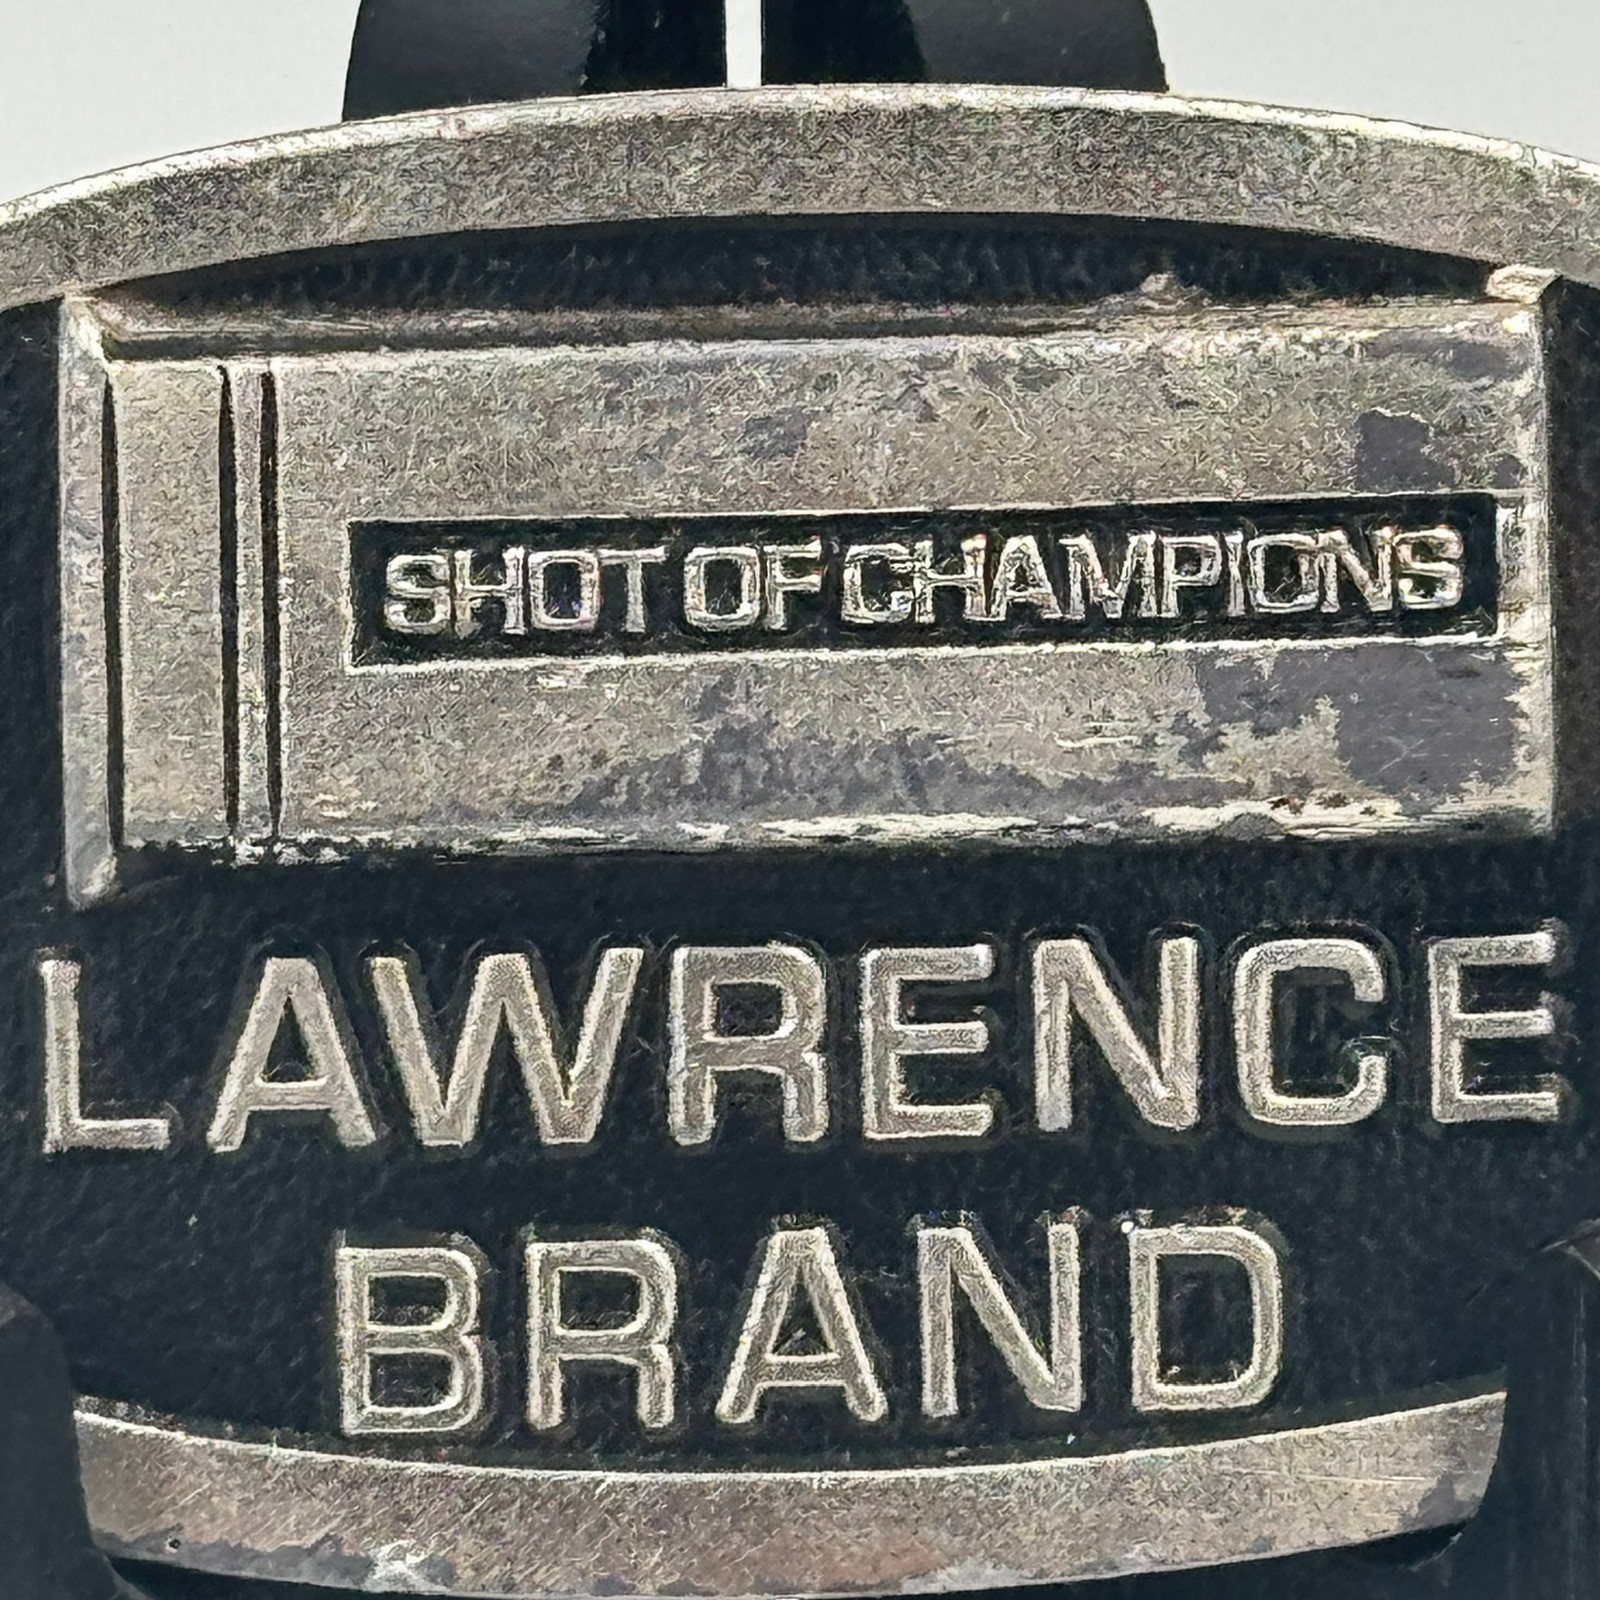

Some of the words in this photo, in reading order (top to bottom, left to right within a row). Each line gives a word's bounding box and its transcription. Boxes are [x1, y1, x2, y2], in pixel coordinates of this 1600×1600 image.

[383, 545, 667, 635] SHOT
[683, 537, 823, 632] OF
[840, 525, 1465, 626] CHAMPIONS
[38, 926, 1562, 1153] LAWRENCE
[335, 1219, 1284, 1437] BRAND
